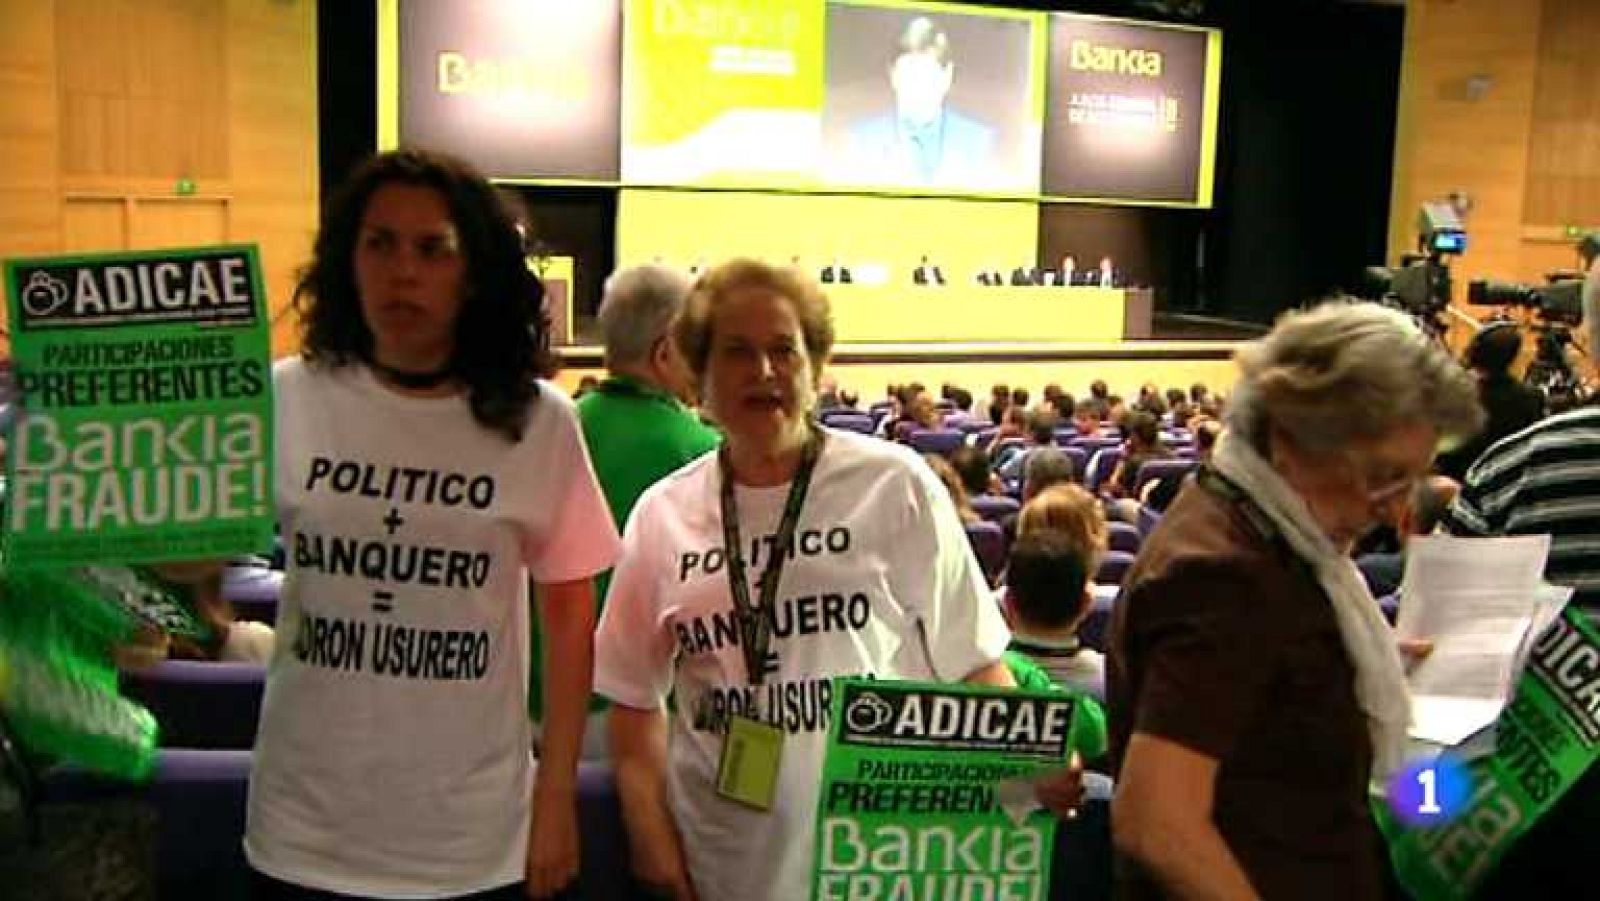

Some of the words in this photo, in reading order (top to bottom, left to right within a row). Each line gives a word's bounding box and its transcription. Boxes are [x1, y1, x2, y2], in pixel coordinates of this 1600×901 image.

[74, 257, 250, 315] ADICAE
[43, 336, 235, 367] PARTICIPACIONES
[20, 359, 264, 408] PREFERENTES
[14, 412, 262, 472] Bankia
[12, 461, 267, 532] FRAUDE!
[306, 457, 495, 510] POLITICO
[294, 532, 491, 588] BANQUERO
[680, 527, 850, 582] POITICO
[675, 592, 870, 654] BANUERO
[371, 621, 490, 681] USURERO
[768, 679, 833, 734] USUR
[893, 693, 1074, 742] ADICAE
[830, 781, 996, 815] PREFEREN
[822, 816, 1042, 873] Bankia
